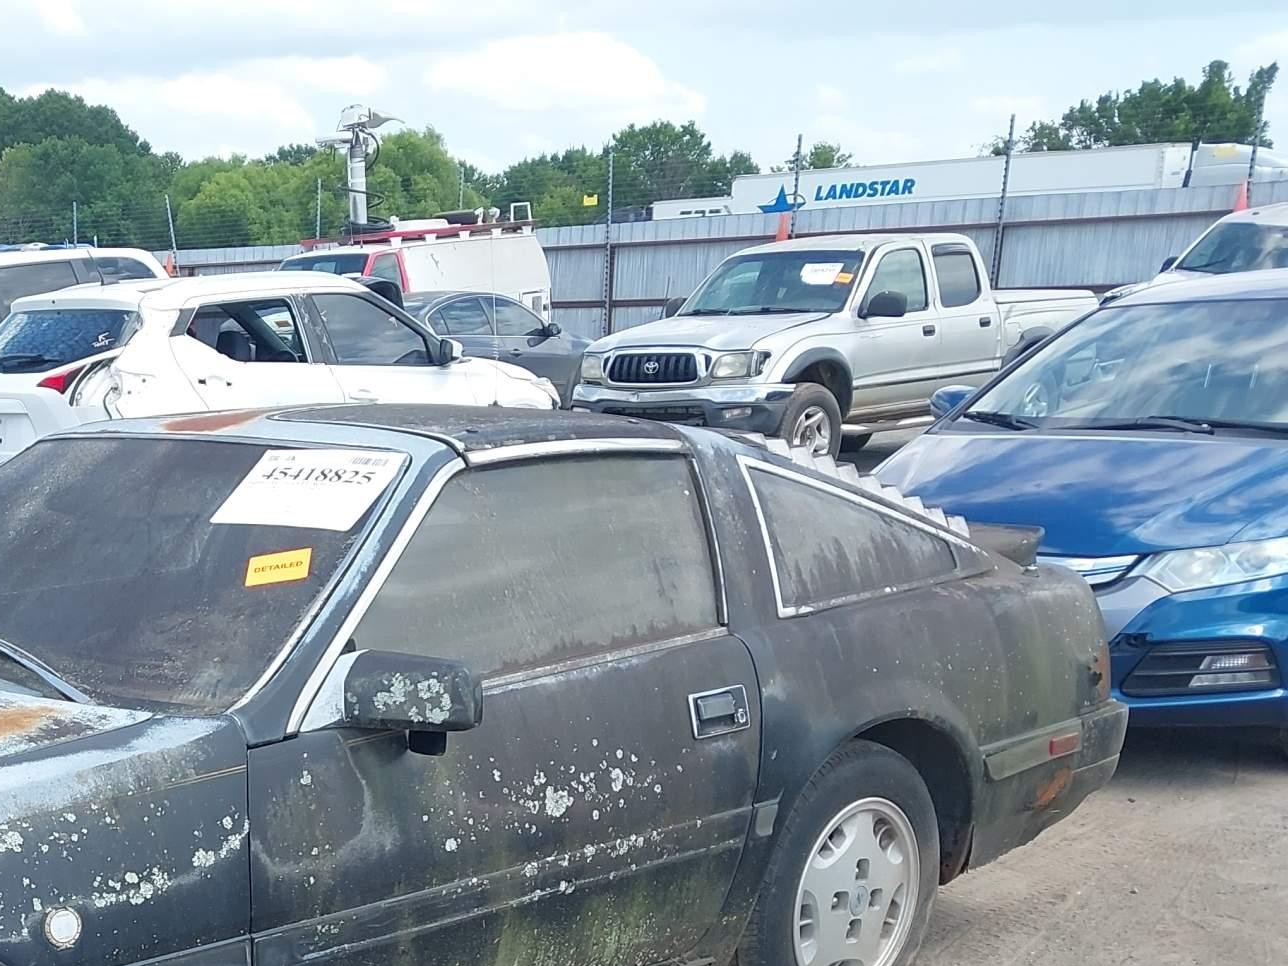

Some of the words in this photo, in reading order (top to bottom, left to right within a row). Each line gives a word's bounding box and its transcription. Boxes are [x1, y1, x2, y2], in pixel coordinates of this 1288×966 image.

[814, 178, 916, 201] LANDSTAR
[262, 466, 377, 485] 45418825
[253, 560, 304, 574] DETAILED
